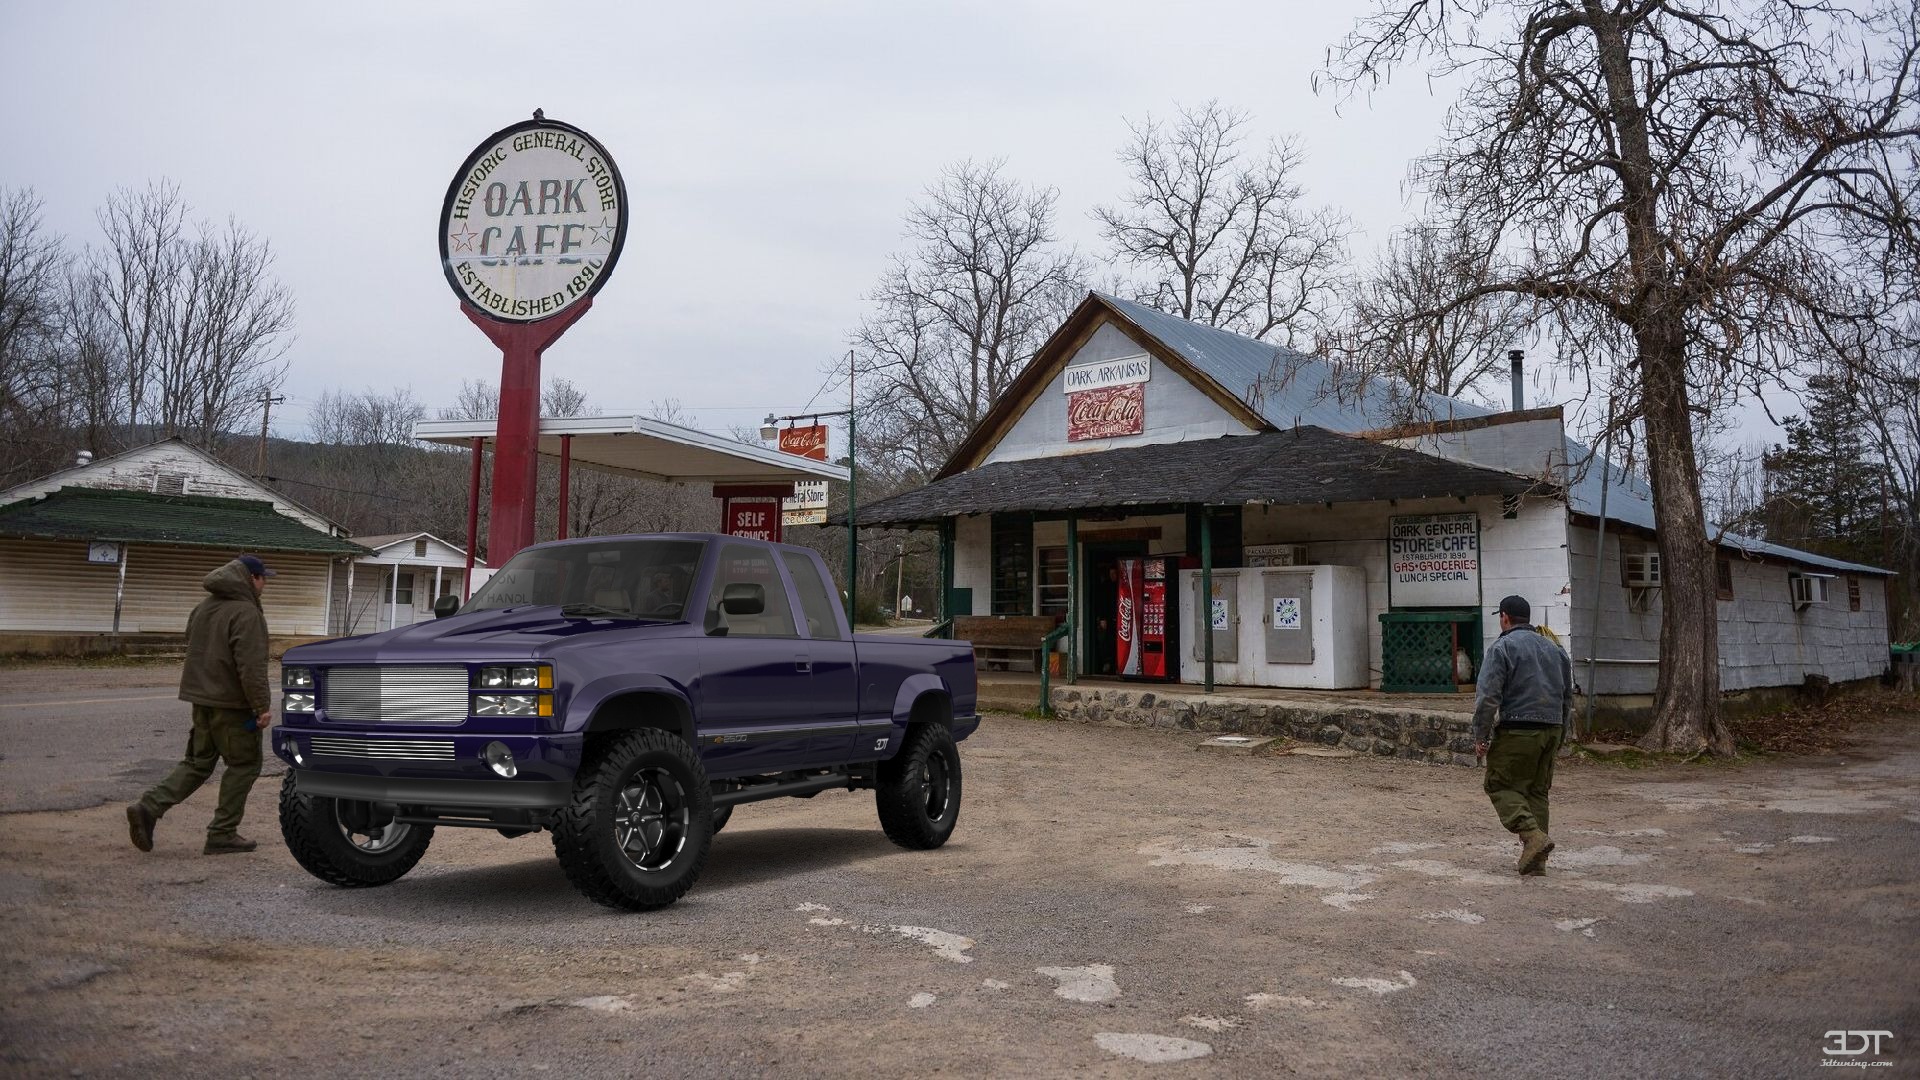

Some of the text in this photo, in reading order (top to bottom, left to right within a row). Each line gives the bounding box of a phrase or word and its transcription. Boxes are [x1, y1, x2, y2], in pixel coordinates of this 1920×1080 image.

[455, 131, 617, 219] HISTORIC GENERAL STORE
[483, 177, 588, 217] OARK
[479, 223, 586, 266] CAFE
[457, 260, 565, 316] ESTABLISHED
[1097, 362, 1147, 382] ARKANSAS
[780, 431, 822, 449] Coca-Cola
[807, 487, 824, 502] Store
[737, 511, 766, 527] SELF
[1393, 522, 1476, 537] OARK GENERAL
[1393, 538, 1435, 554] STORE
[1442, 536, 1477, 552] CAFE
[1267, 556, 1290, 566] ICE
[1449, 551, 1467, 560] 1890
[1393, 560, 1477, 573] GAS GROCERIES
[1399, 571, 1469, 583] LUNCH SPECIAL
[1118, 595, 1132, 642] Coca-Cola
[723, 734, 748, 743] 2500
